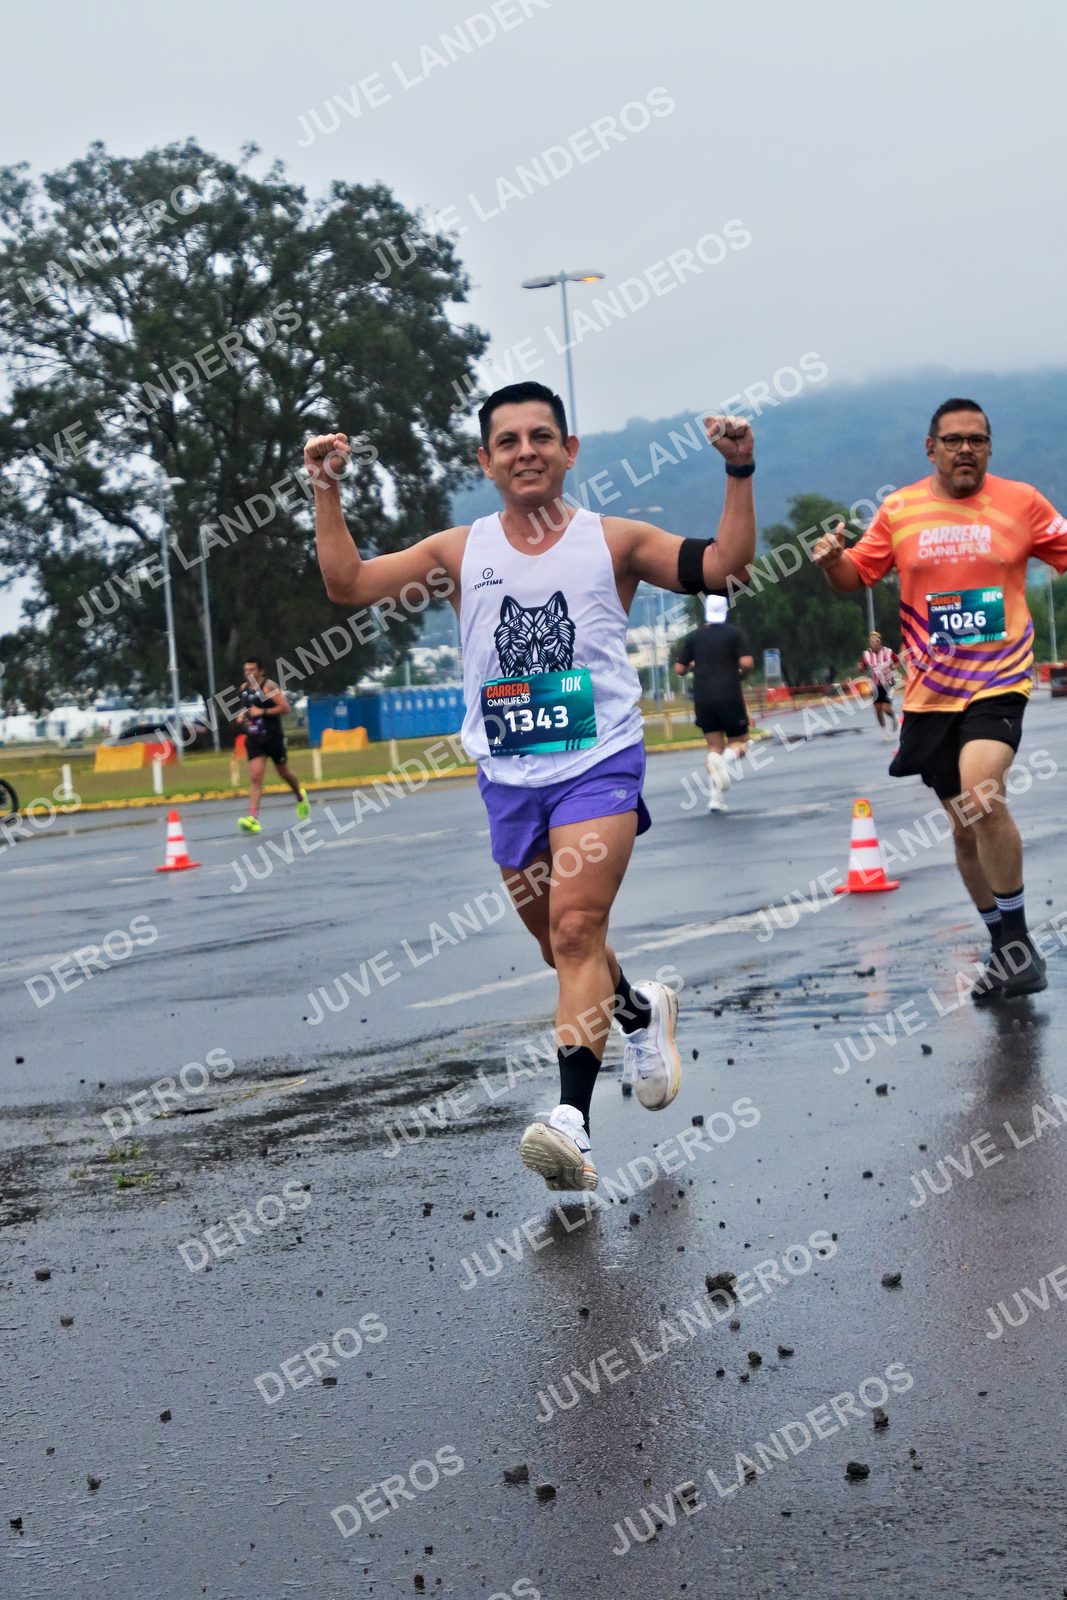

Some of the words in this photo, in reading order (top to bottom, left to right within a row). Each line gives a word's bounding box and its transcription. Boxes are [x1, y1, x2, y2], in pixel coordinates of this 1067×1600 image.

[919, 524, 991, 546] CARRERA
[918, 543, 976, 559] OMNILIFE
[474, 579, 503, 590] TOPTIME
[940, 611, 987, 630] 1026
[486, 682, 531, 699] CARRERA
[560, 676, 582, 693] 10K
[504, 705, 569, 732] 1343
